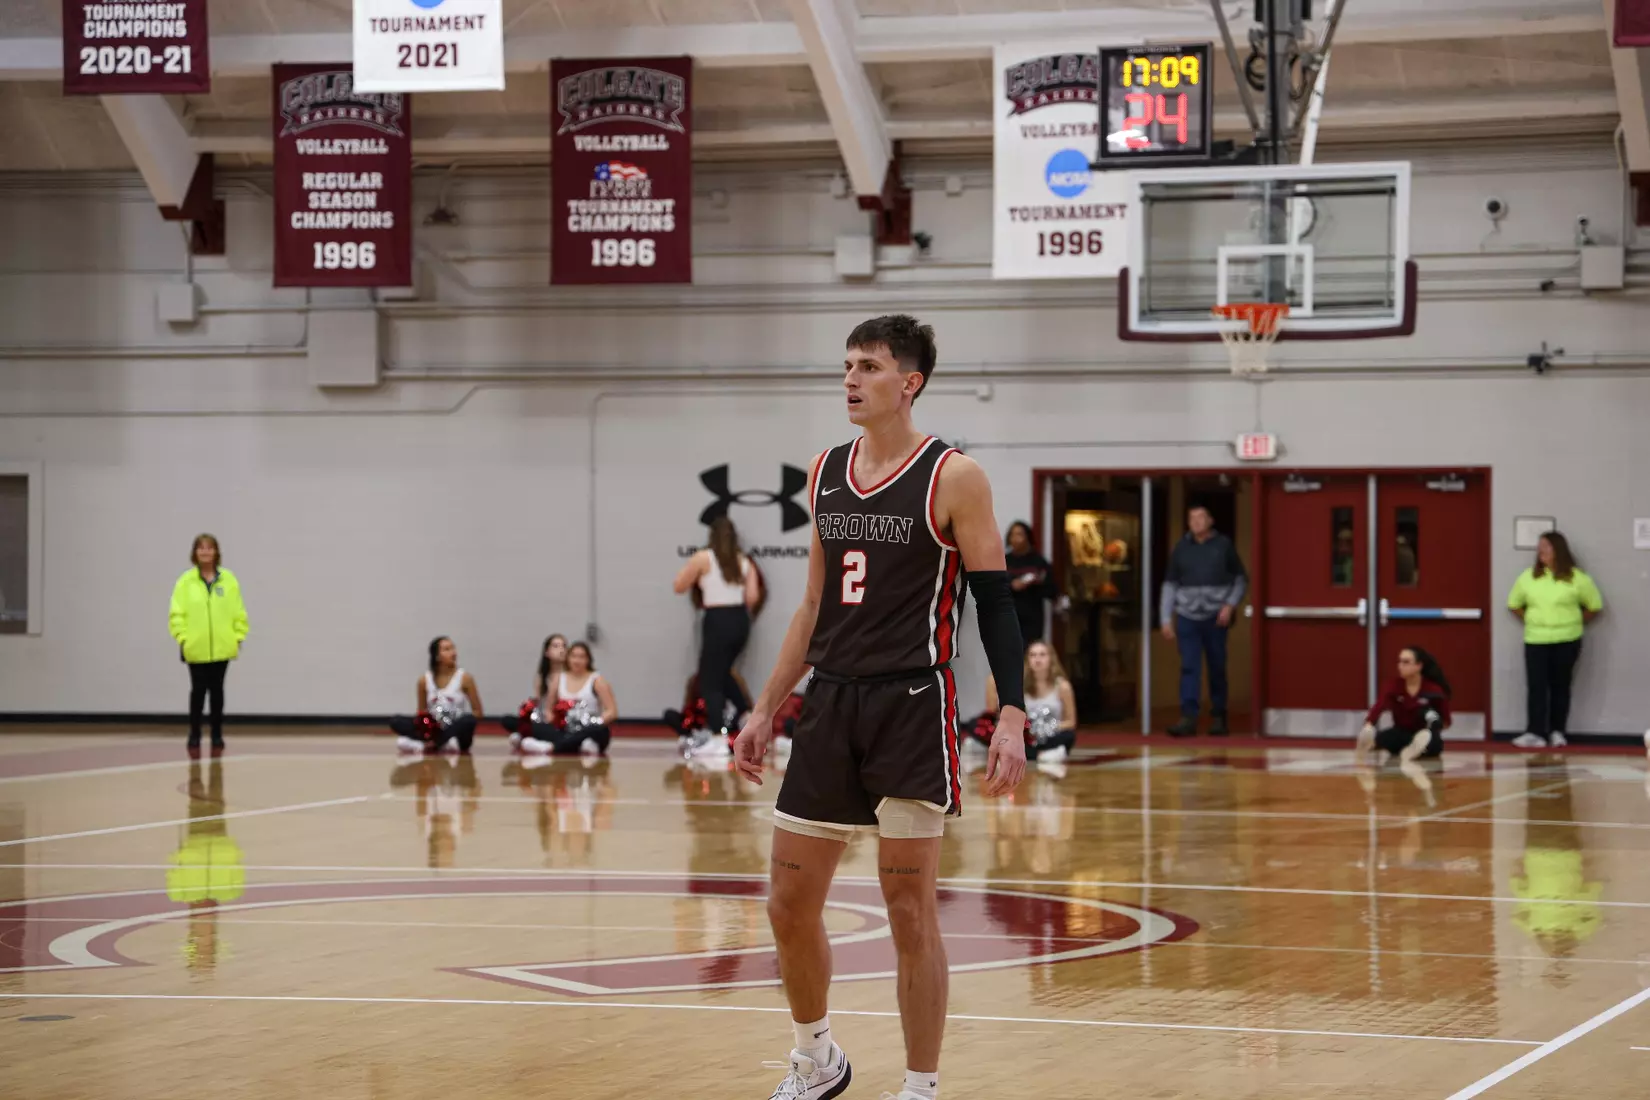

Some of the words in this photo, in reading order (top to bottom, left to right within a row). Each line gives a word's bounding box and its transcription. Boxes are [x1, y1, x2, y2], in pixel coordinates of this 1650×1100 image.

[83, 4, 186, 20] TOURNAMENT
[83, 20, 187, 38] CHAMPIONS
[370, 14, 485, 32] TOURNAMENT
[80, 46, 191, 74] 2020-21
[397, 43, 459, 69] 2021
[1006, 54, 1099, 94] COLGA
[1122, 55, 1200, 88] 17:09
[562, 69, 683, 106] COLGATE
[1123, 92, 1188, 148] 24
[1021, 123, 1099, 139] VOLLEYBA
[296, 138, 388, 155] VOLLEYBALL
[574, 135, 669, 151] VOLLEYBALL
[302, 172, 383, 190] REGULAR
[308, 192, 376, 209] SEASON
[567, 199, 675, 215] TOURNAMENT
[291, 211, 394, 229] CHAMPIONS
[1009, 204, 1128, 222] TOURNAMENT
[568, 215, 675, 232] CHAMPIONS
[591, 239, 655, 266] 1996
[1037, 231, 1103, 257] 1996
[313, 242, 376, 270] 1996
[1243, 434, 1270, 458] EXIT
[818, 513, 913, 544] BROWN
[751, 546, 809, 558] ARMO
[841, 549, 867, 605] 2
